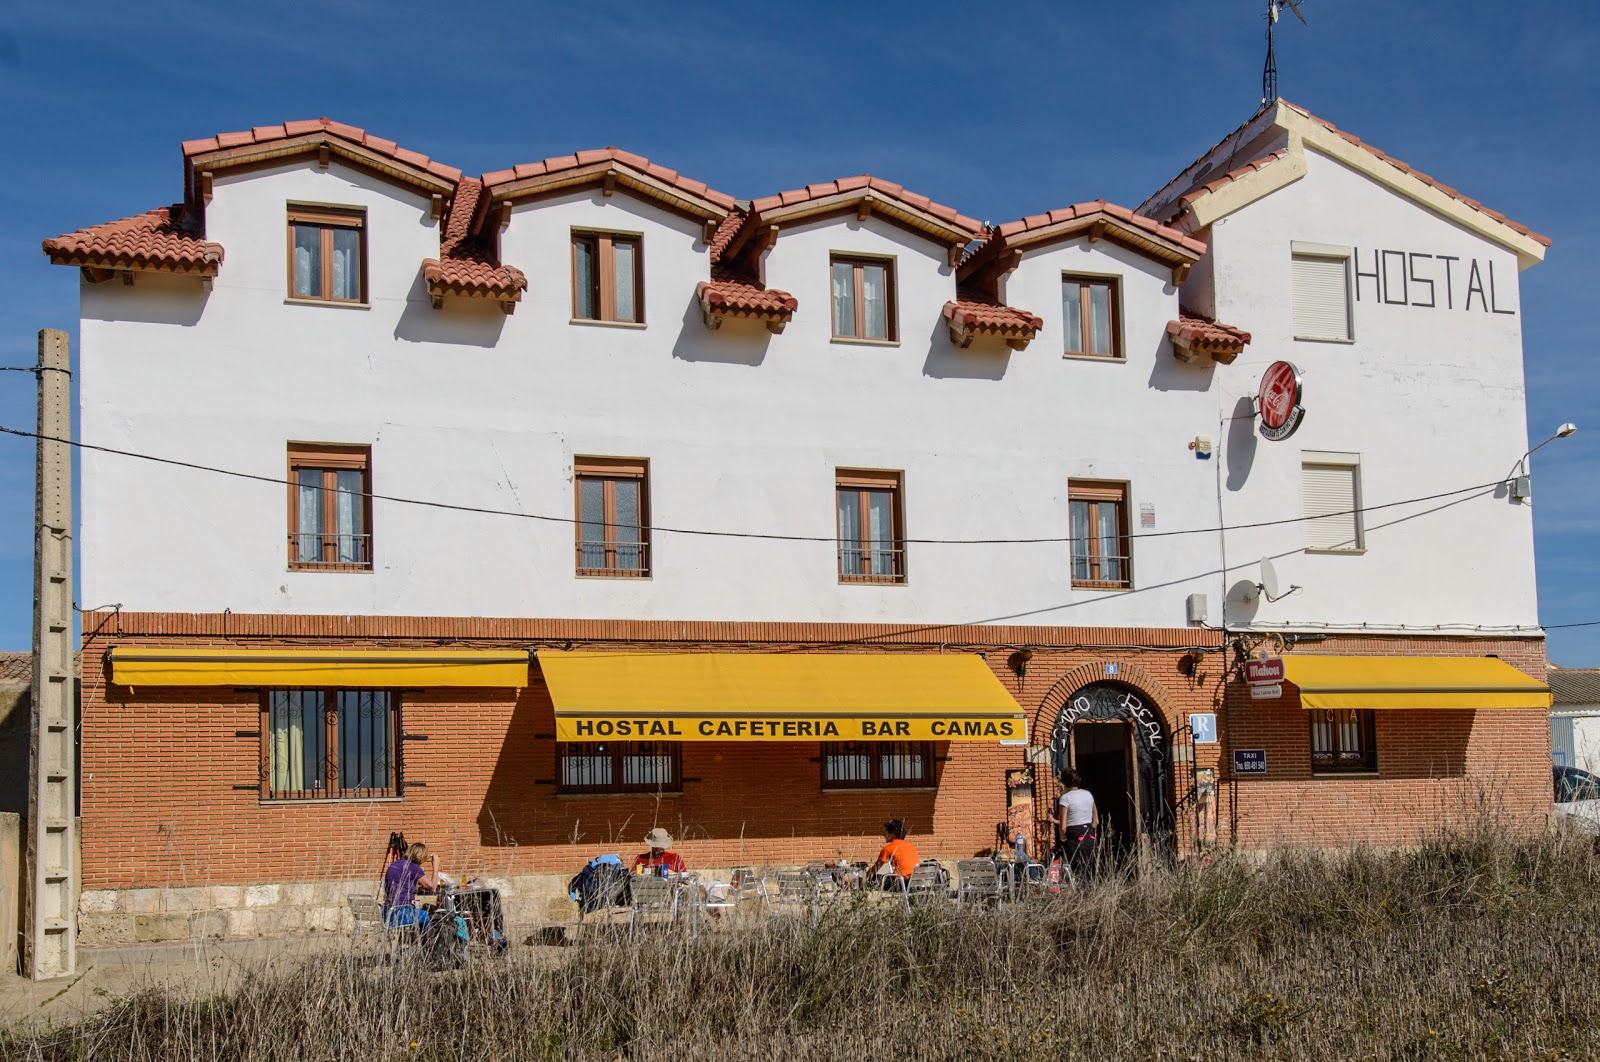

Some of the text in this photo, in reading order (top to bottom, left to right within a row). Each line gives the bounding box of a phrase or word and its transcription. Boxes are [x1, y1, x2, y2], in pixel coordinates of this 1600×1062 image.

[1354, 246, 1516, 315] HOSTAL
[1109, 665, 1114, 674] 8
[1249, 664, 1280, 677] Mahou
[1121, 693, 1162, 748] REAL
[1198, 717, 1209, 731] R
[576, 720, 1014, 737] HOSTAL CAFETERIA BAR CAMAS
